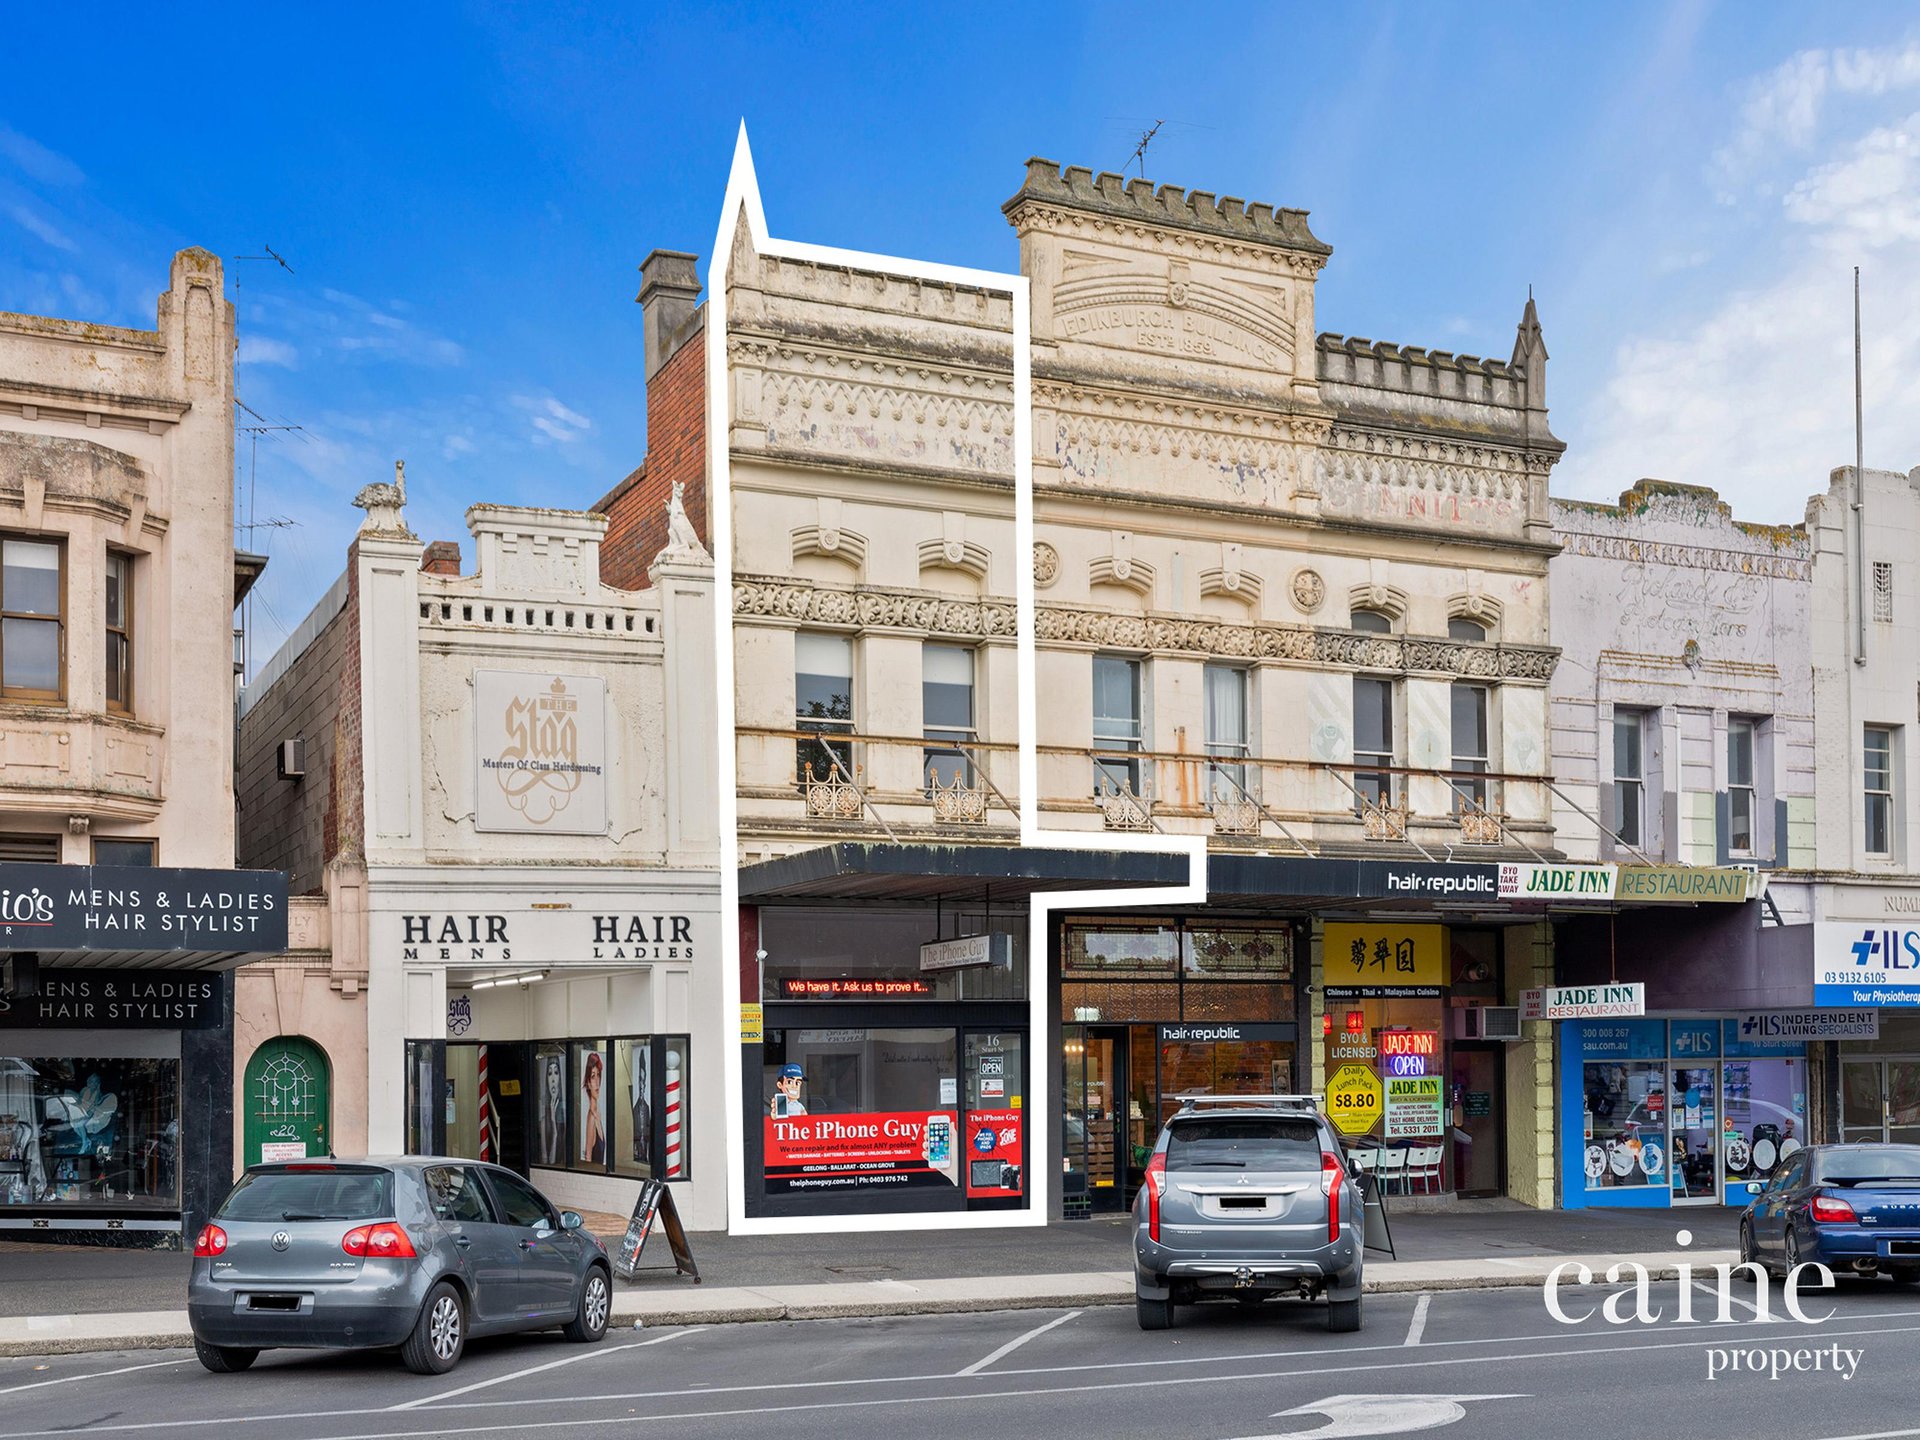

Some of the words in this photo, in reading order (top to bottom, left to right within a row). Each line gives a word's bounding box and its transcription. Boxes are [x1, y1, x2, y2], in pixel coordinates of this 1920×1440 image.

[1061, 308, 1175, 337] EDINBURGH
[545, 700, 573, 710] THE
[483, 758, 515, 769] Masters
[516, 760, 529, 769] Of
[530, 761, 550, 771] Class
[552, 762, 601, 775] Hairdressing
[1502, 866, 1518, 876] BYO
[1499, 875, 1518, 885] TAKE
[1526, 869, 1575, 892] JADE
[1578, 871, 1611, 893] INN
[1622, 873, 1743, 896] RESTAURANT
[68, 888, 141, 908] MENS
[156, 891, 170, 907] &
[186, 892, 274, 911] LADIES
[85, 912, 146, 931] HAIR
[161, 914, 260, 933] STYLIST
[402, 914, 510, 944] HAIR
[592, 915, 693, 944] HAIR
[403, 948, 511, 960] MENS
[593, 946, 694, 960] LADIES
[923, 947, 938, 963] The
[939, 943, 967, 961] iPhone
[968, 939, 988, 959] Guy
[1883, 930, 1920, 969] ILS
[1824, 971, 1836, 983] 03
[1839, 971, 1862, 983] 9132
[1863, 972, 1887, 983] 6105
[32, 982, 90, 998] ENS
[104, 983, 117, 998] &
[132, 983, 212, 998] LADIES
[788, 981, 805, 992] We
[806, 980, 830, 992] have
[843, 981, 860, 992] Ask
[861, 983, 873, 992] us
[874, 982, 885, 992] to
[885, 983, 912, 994] prove
[1326, 988, 1353, 996] Chinese
[1362, 988, 1376, 996] Thai
[1384, 988, 1415, 997] Malaysian
[1526, 991, 1540, 1000] BYO
[1553, 988, 1598, 1006] JADE
[1603, 986, 1634, 1003] INN
[1852, 990, 1872, 1002] Your
[40, 1003, 95, 1018] HAIR
[109, 1003, 199, 1019] STYLIST
[1548, 1003, 1640, 1017] RESTAURANT
[1759, 1015, 1781, 1035] ILS
[1781, 1012, 1874, 1024] INDEPENDENT
[1782, 1025, 1817, 1035] LIVING
[1817, 1024, 1875, 1035] SPECIALISTS
[1340, 1032, 1359, 1044] BYO
[1361, 1033, 1368, 1043] &
[1582, 1028, 1598, 1038] 300
[1598, 1028, 1614, 1037] 008
[1615, 1028, 1630, 1037] 267
[986, 1034, 1000, 1047] 16
[1384, 1034, 1412, 1054] JADE
[1413, 1034, 1433, 1054] INN
[1583, 1041, 1628, 1051] sau.com.au
[1691, 1033, 1712, 1051] ILS
[1331, 1047, 1378, 1058] LICENSED
[981, 1063, 1002, 1073] OPEN
[1343, 1066, 1366, 1077] Daily
[1394, 1055, 1425, 1076] OPEN
[1336, 1078, 1357, 1091] Lunch
[1358, 1079, 1374, 1091] Pack
[1389, 1080, 1417, 1095] JADE
[1419, 1080, 1438, 1094] INN
[1335, 1093, 1375, 1109] $8.80
[970, 1114, 983, 1122] The
[1005, 1113, 1019, 1122] Guy
[773, 1123, 811, 1141] The
[815, 1120, 879, 1140] iPhone
[883, 1119, 922, 1140] Guy
[1389, 1126, 1402, 1135] Tel.
[1403, 1125, 1420, 1134] 5331
[1422, 1125, 1439, 1133] 2011
[804, 1144, 826, 1153] repair
[889, 1141, 917, 1151] problem
[802, 1164, 828, 1172] GEELONG
